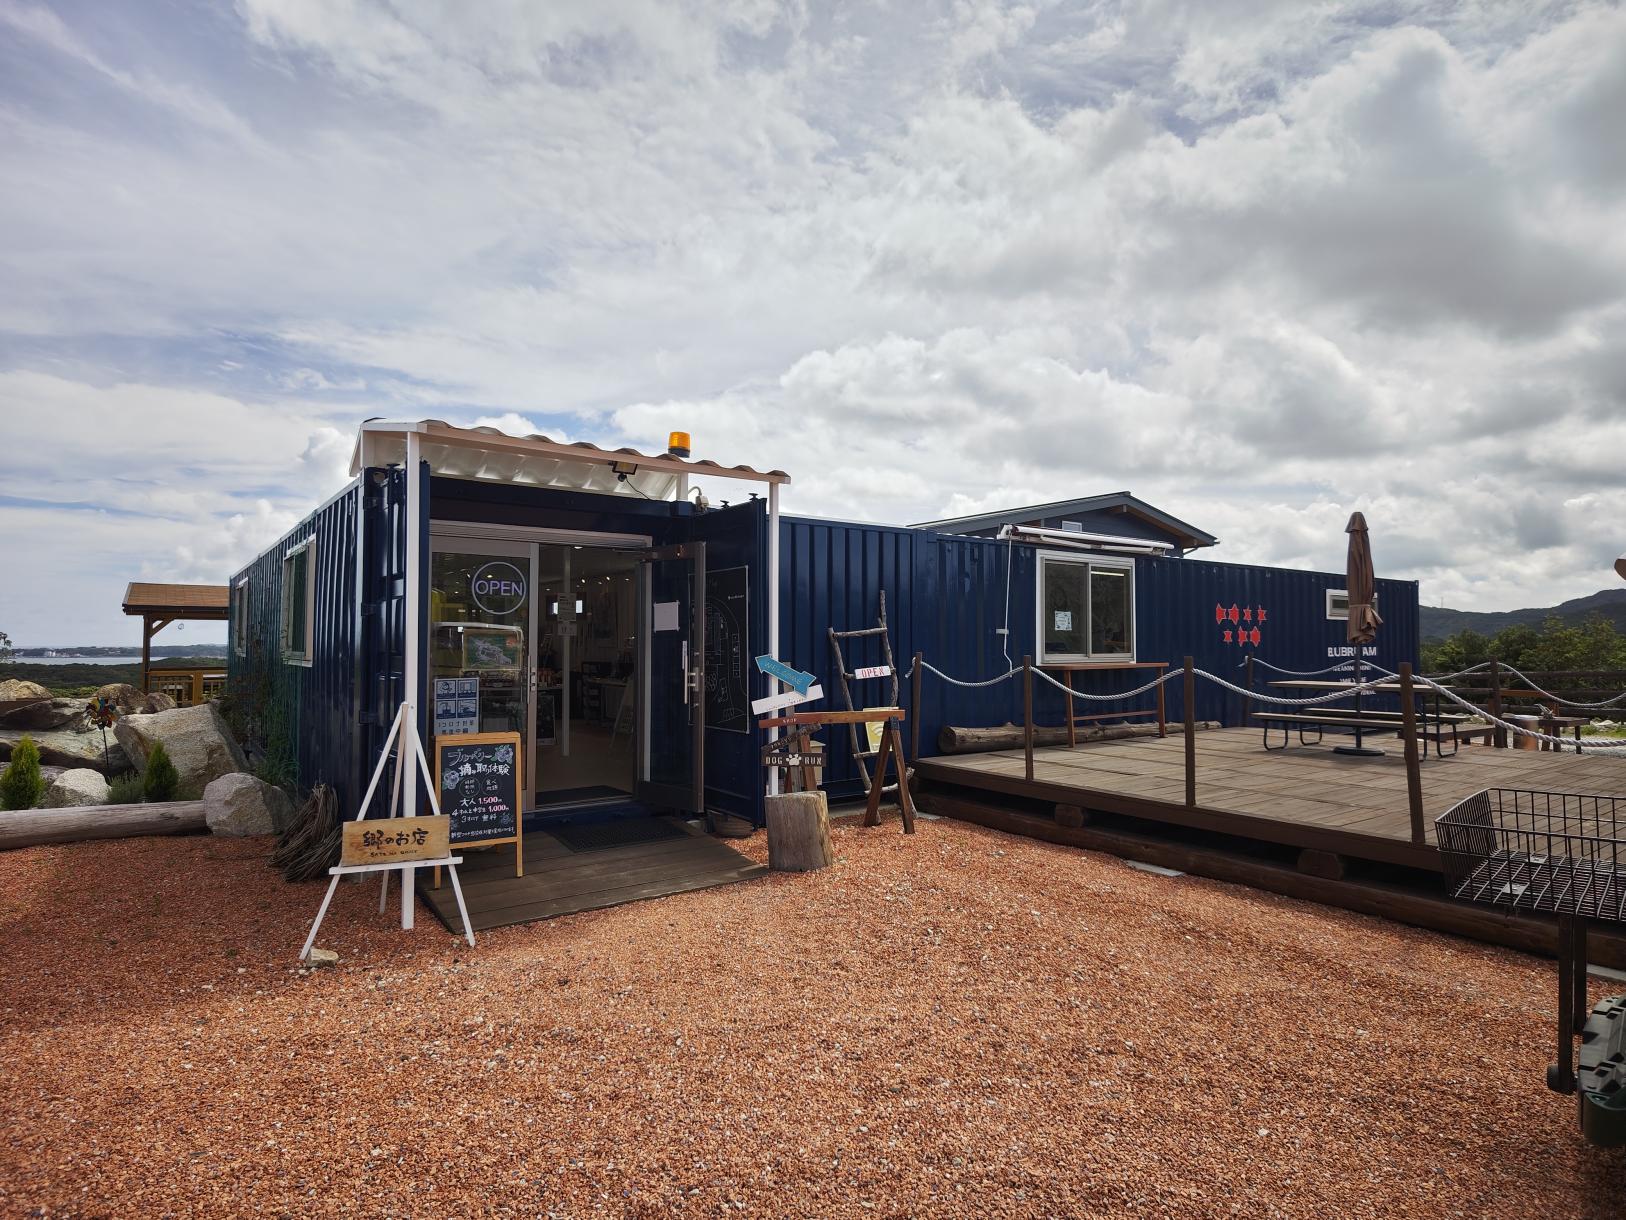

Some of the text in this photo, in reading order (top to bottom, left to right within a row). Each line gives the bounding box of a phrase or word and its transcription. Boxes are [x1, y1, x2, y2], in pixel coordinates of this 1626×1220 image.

[475, 580, 523, 596] OPEN
[861, 666, 886, 678] OPEN
[765, 756, 822, 765] DOG RUN
[459, 797, 477, 807] 大人
